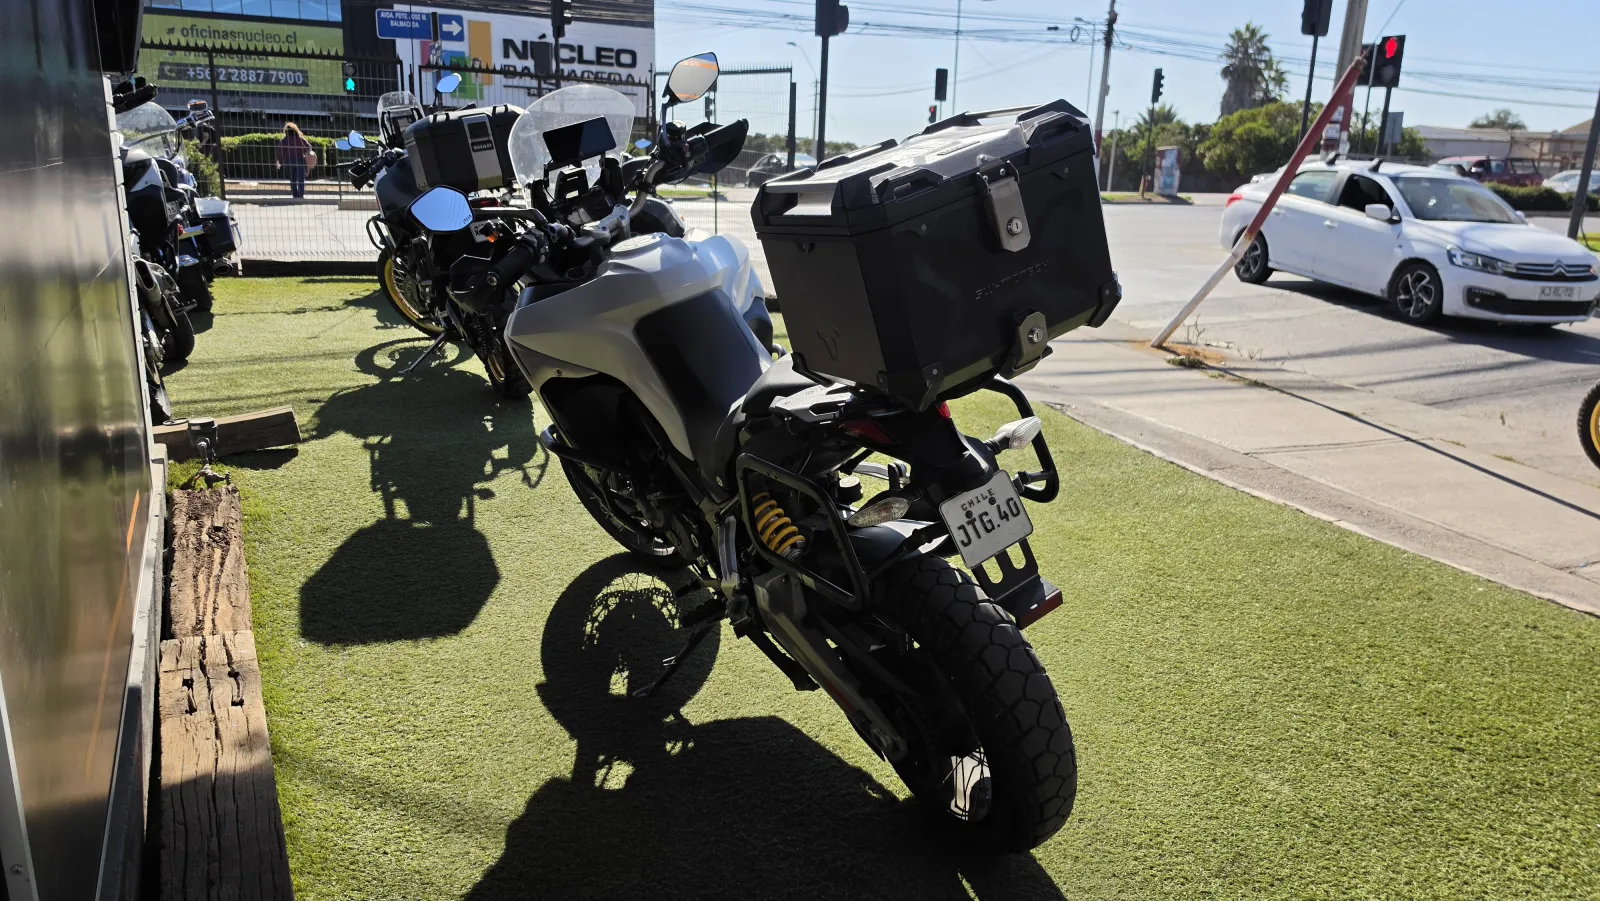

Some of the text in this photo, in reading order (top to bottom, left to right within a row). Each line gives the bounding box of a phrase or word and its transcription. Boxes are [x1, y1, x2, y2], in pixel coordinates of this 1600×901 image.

[181, 24, 297, 44] oficinasnucleo.cl
[390, 20, 420, 28] BALMACDA
[502, 33, 637, 69] NCLEO
[187, 67, 303, 84] +56 2 2887 7900
[503, 64, 637, 85] BAACEDA
[961, 488, 995, 511] CHILE
[957, 497, 1021, 548] JTG.40
